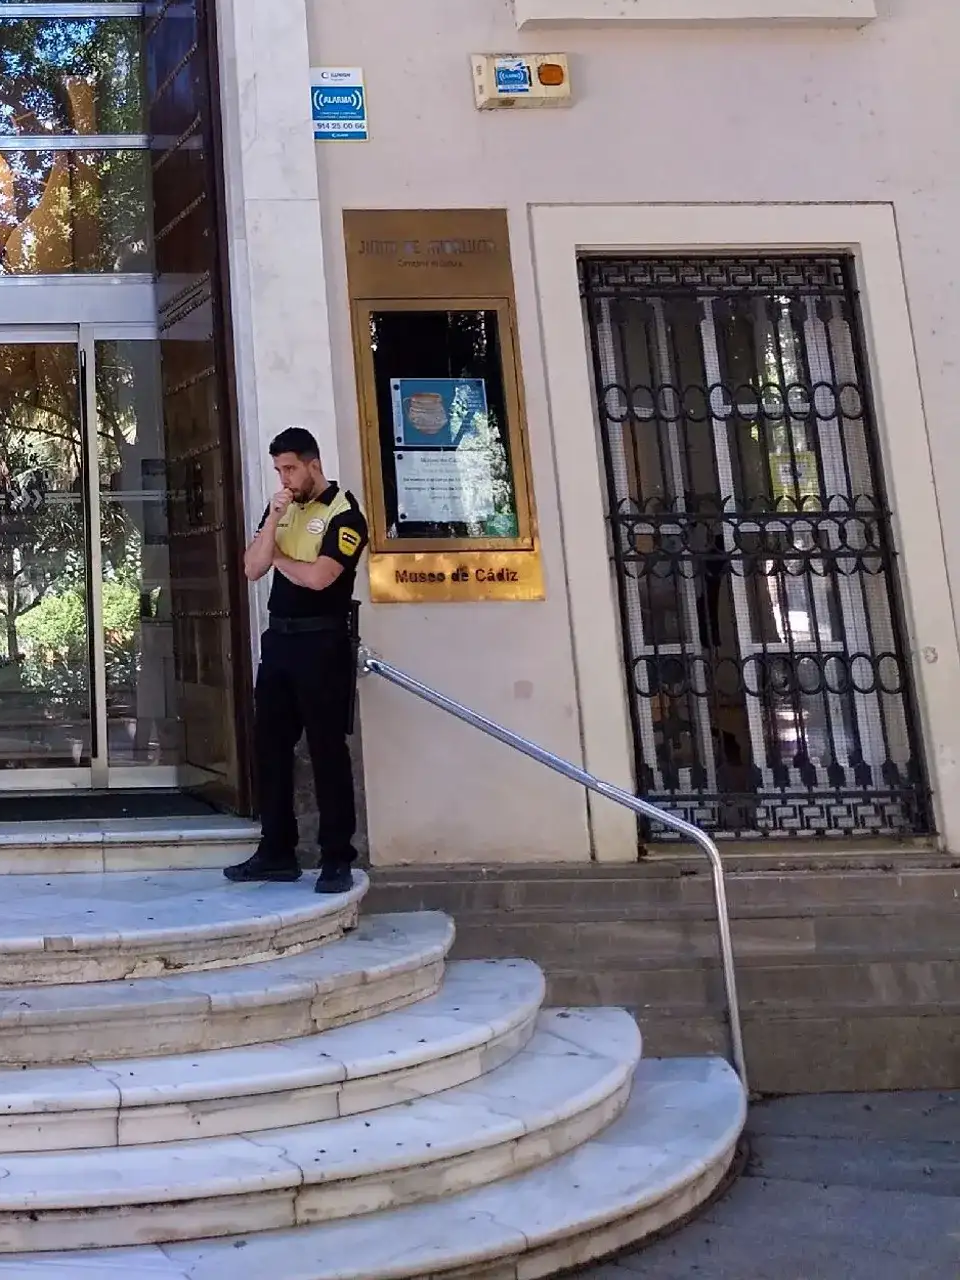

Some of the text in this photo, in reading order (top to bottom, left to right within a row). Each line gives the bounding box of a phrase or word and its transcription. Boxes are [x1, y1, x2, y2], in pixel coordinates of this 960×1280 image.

[323, 96, 352, 104] ALARMA
[395, 567, 519, 584] Museo de Cádiz
